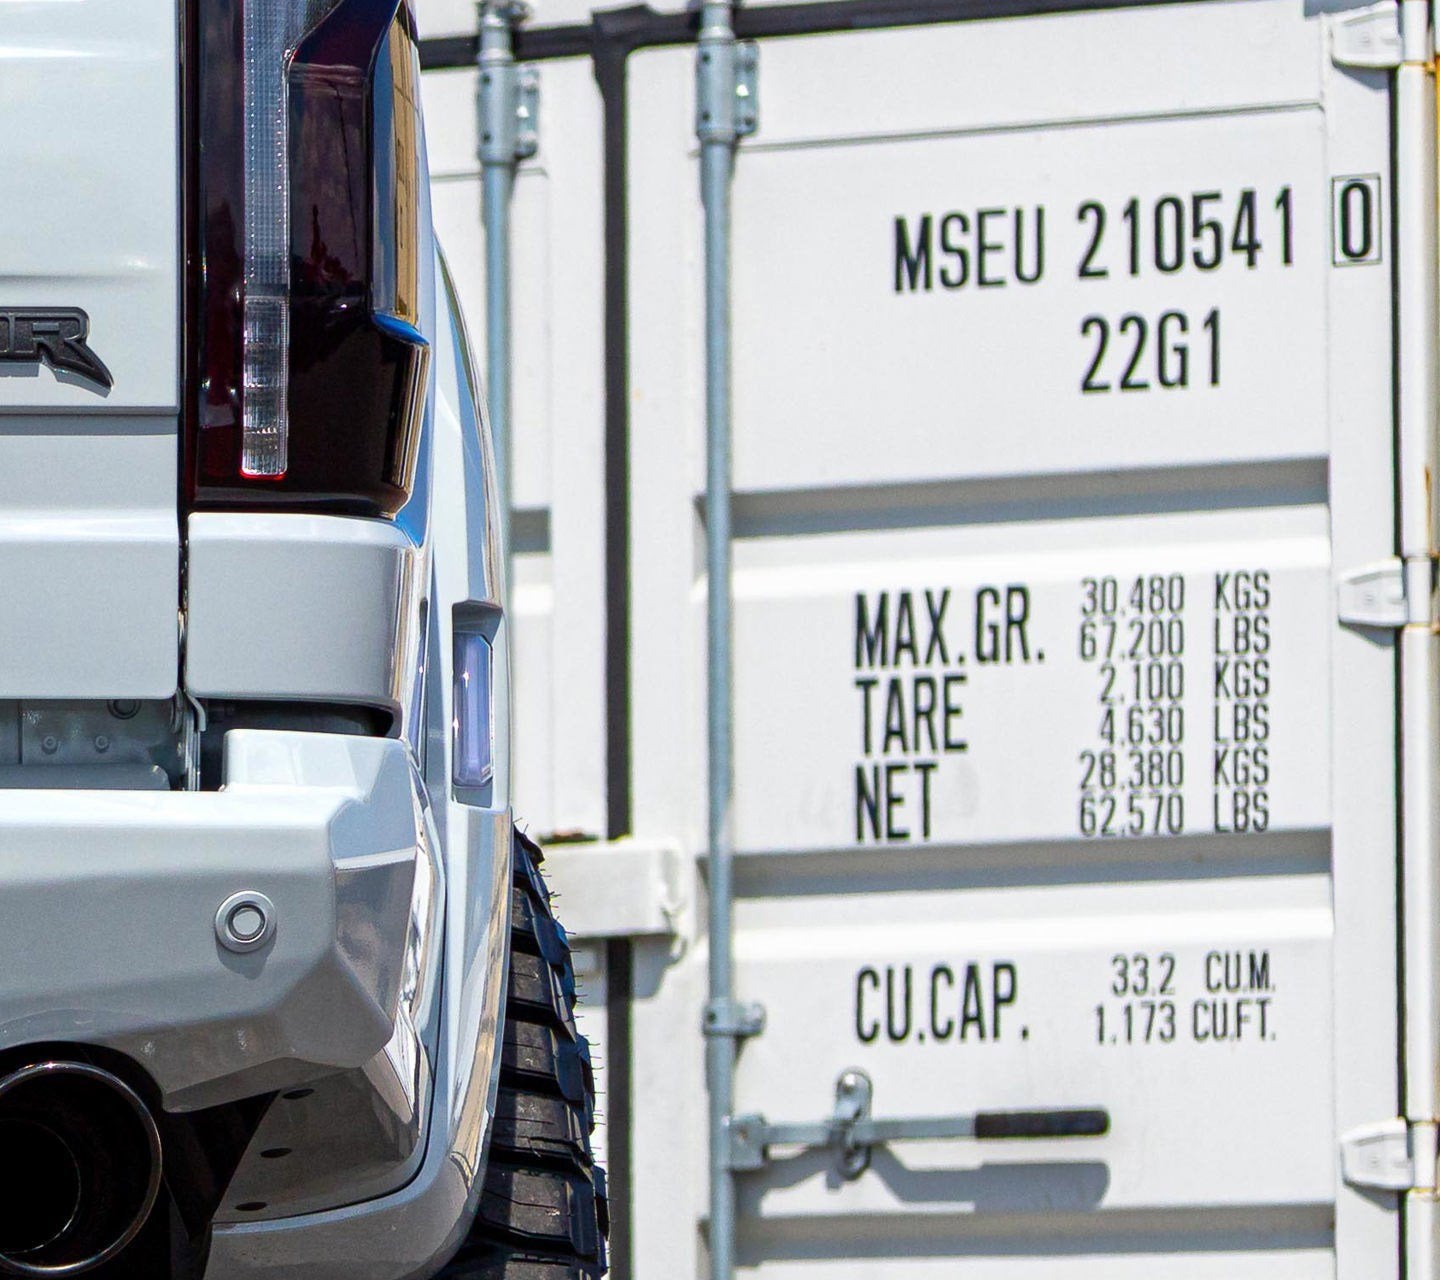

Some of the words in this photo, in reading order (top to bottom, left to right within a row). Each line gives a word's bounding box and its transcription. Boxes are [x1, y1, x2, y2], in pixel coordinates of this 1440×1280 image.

[894, 205, 1046, 295] MSEU
[1076, 184, 1294, 280] 210541
[1341, 181, 1373, 260] 0
[1080, 307, 1221, 395] 22G1
[854, 583, 1046, 669] MAX.GR.
[1080, 574, 1185, 617] 30.480
[1215, 569, 1271, 611] KGS
[1080, 618, 1185, 662] 67.200
[1215, 614, 1271, 656] LBS
[854, 673, 969, 755] TARE
[1099, 660, 1185, 704] 2.100
[1215, 657, 1271, 700] KGS
[1100, 704, 1185, 746] 4.630
[1214, 702, 1270, 744] LBS
[854, 761, 940, 843] NET
[1079, 748, 1185, 790] 28.380
[1214, 745, 1270, 787] KGS
[1080, 792, 1185, 836] 62.570
[1214, 789, 1270, 833] LBS
[854, 960, 1030, 1046] CU.CAP.
[1111, 952, 1176, 997] 33.2
[1095, 1000, 1176, 1045] 1.173
